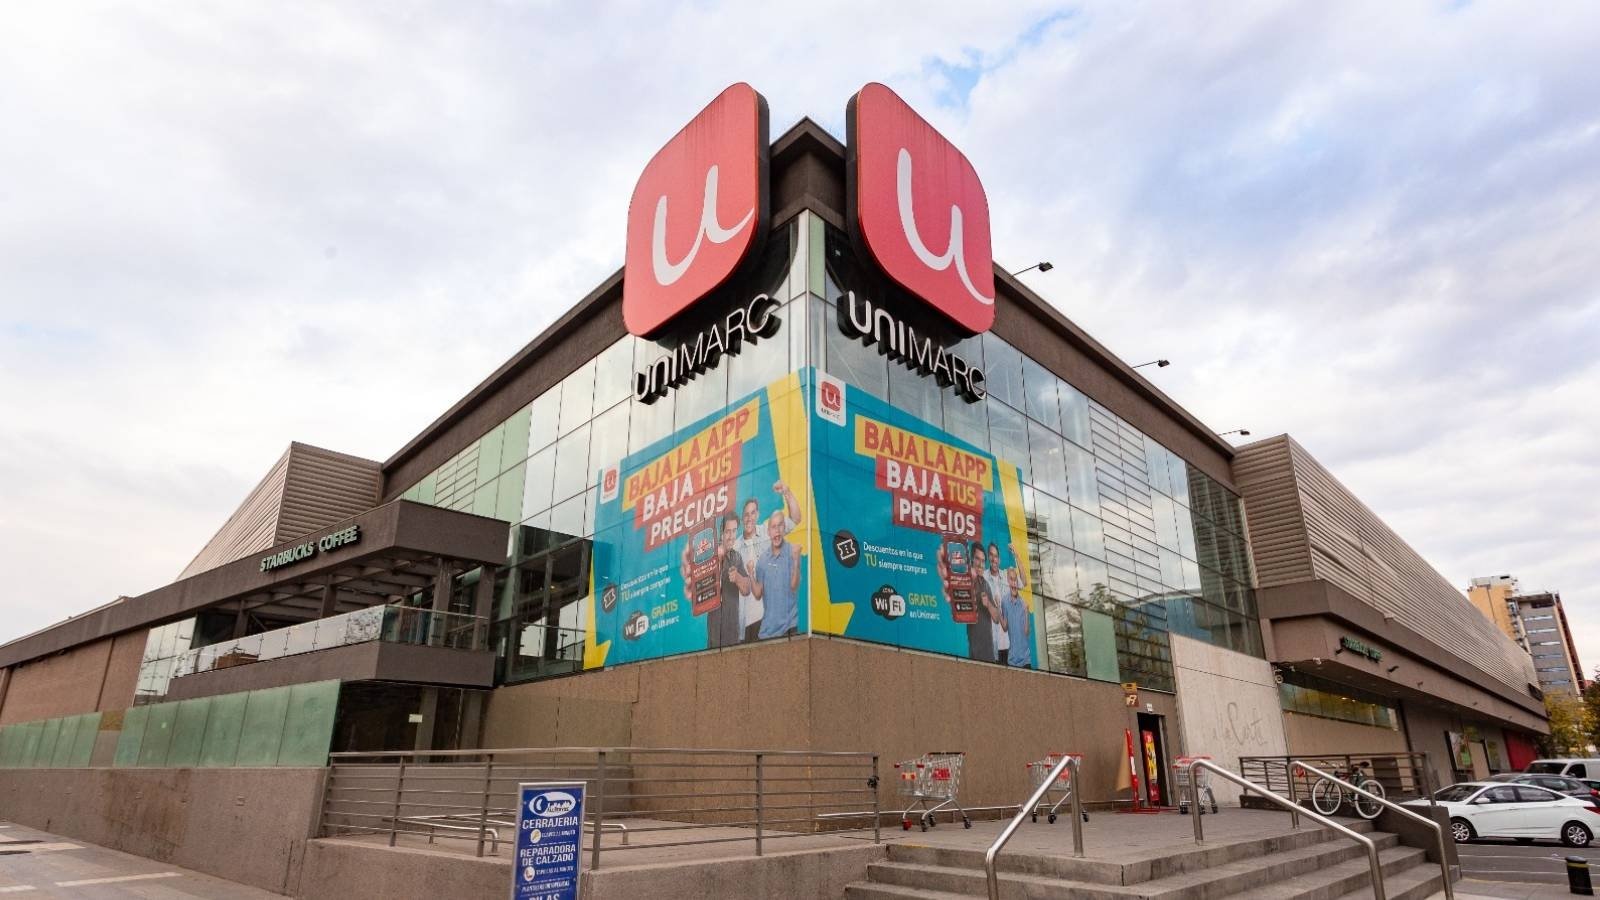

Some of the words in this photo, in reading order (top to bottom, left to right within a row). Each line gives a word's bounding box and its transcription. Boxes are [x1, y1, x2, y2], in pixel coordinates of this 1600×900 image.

[633, 293, 772, 402] UNIMARC
[848, 291, 987, 401] UNIMARC
[629, 455, 673, 497] BAJA
[678, 437, 700, 471] LA
[706, 407, 750, 456] APP
[864, 421, 920, 463] BAJA
[924, 440, 948, 473] LA
[950, 451, 987, 481] APP
[642, 471, 694, 522] BAJA
[700, 451, 732, 488] TUS
[886, 459, 944, 500] BAJA
[947, 479, 976, 507] TUS
[650, 485, 729, 545] PRECIOS
[899, 498, 976, 537] PRECIOS
[260, 541, 314, 572] STARBUCKS
[319, 525, 358, 552] COFFEE
[863, 541, 899, 556] Descuentos
[864, 552, 877, 567] TU
[878, 559, 903, 573] siempre
[651, 599, 679, 619] GRATIS
[908, 592, 937, 607] GRATIS
[522, 816, 579, 829] CERRAJERIA
[520, 844, 576, 858] REPARADORA
[522, 858, 534, 867] DE
[536, 853, 574, 865] CALZADO
